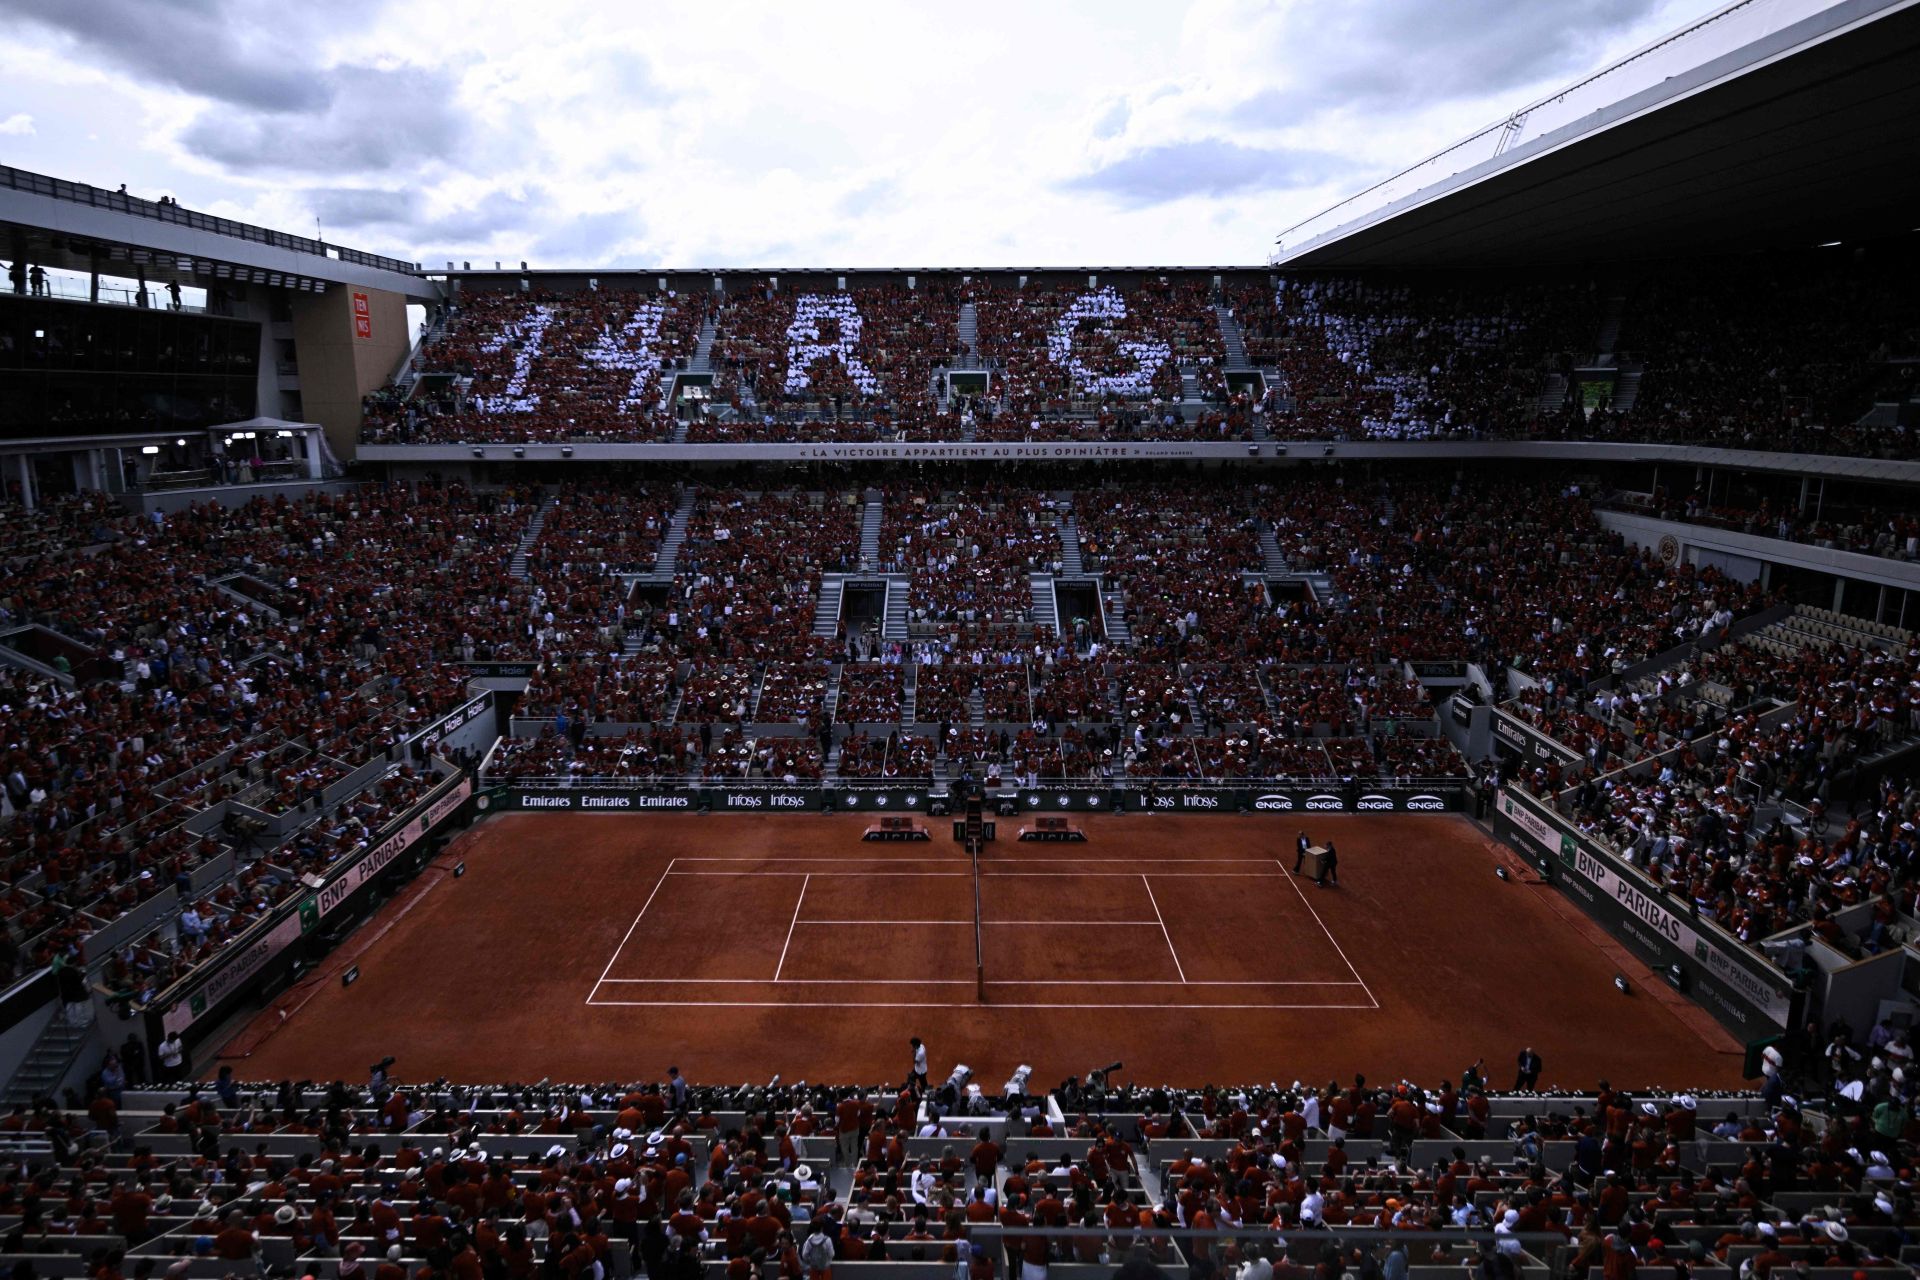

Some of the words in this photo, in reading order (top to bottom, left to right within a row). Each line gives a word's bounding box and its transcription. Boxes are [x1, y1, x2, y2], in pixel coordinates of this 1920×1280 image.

[355, 299, 367, 311] TEN
[813, 449, 827, 457] LA
[834, 449, 897, 457] VICTOIRE
[905, 449, 986, 457] APPARTIENT
[1017, 448, 1048, 456] PLUS
[1055, 446, 1127, 456] OPINIÂTRE
[444, 713, 464, 734] Haier
[467, 700, 486, 719] Haier
[1497, 719, 1527, 746] Emirates
[521, 795, 571, 807] Emirates
[581, 795, 630, 807] Emirates
[639, 795, 688, 807] Emirates
[727, 794, 762, 808] Infosys
[770, 794, 805, 808] Infosys
[1183, 794, 1218, 808] Infosys
[1513, 805, 1525, 818] BNP
[1524, 811, 1547, 836] PARIBAS
[321, 877, 347, 912] BNP
[359, 832, 405, 882] PARIBAS
[1578, 852, 1605, 882] BNP
[1617, 880, 1680, 942] PARIBAS
[208, 972, 229, 997] BNP
[230, 940, 268, 979] PARIBAS
[1710, 950, 1729, 969] BNP
[1729, 965, 1771, 1003] PARIBAS
[1714, 993, 1746, 1024] PARIBAS
